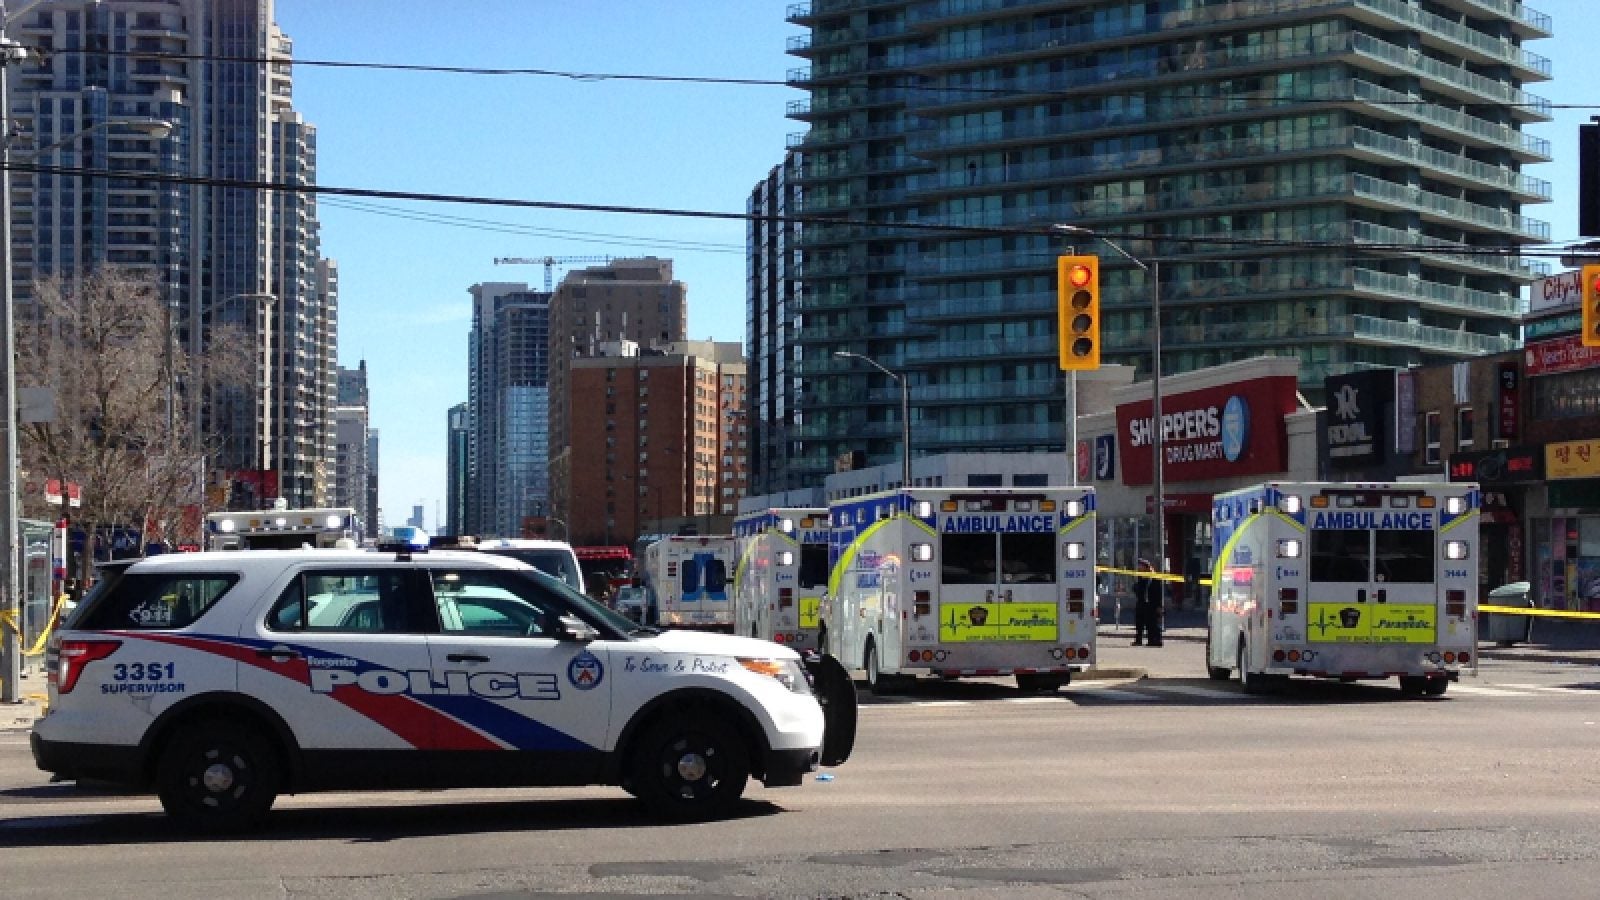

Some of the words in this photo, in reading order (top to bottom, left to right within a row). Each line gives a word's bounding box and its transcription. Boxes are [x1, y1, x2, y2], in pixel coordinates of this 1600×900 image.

[1130, 405, 1219, 447] SHPPERS
[1166, 444, 1195, 464] DRUG
[1195, 441, 1223, 461] MART
[944, 515, 1053, 533] AMBULANCE
[1314, 511, 1433, 530] AMBULANCE
[113, 661, 175, 681] 33S1
[307, 655, 358, 668] Toronto
[674, 659, 685, 672] &
[101, 683, 186, 695] SUPERVISOR
[309, 668, 560, 700] POLICE
